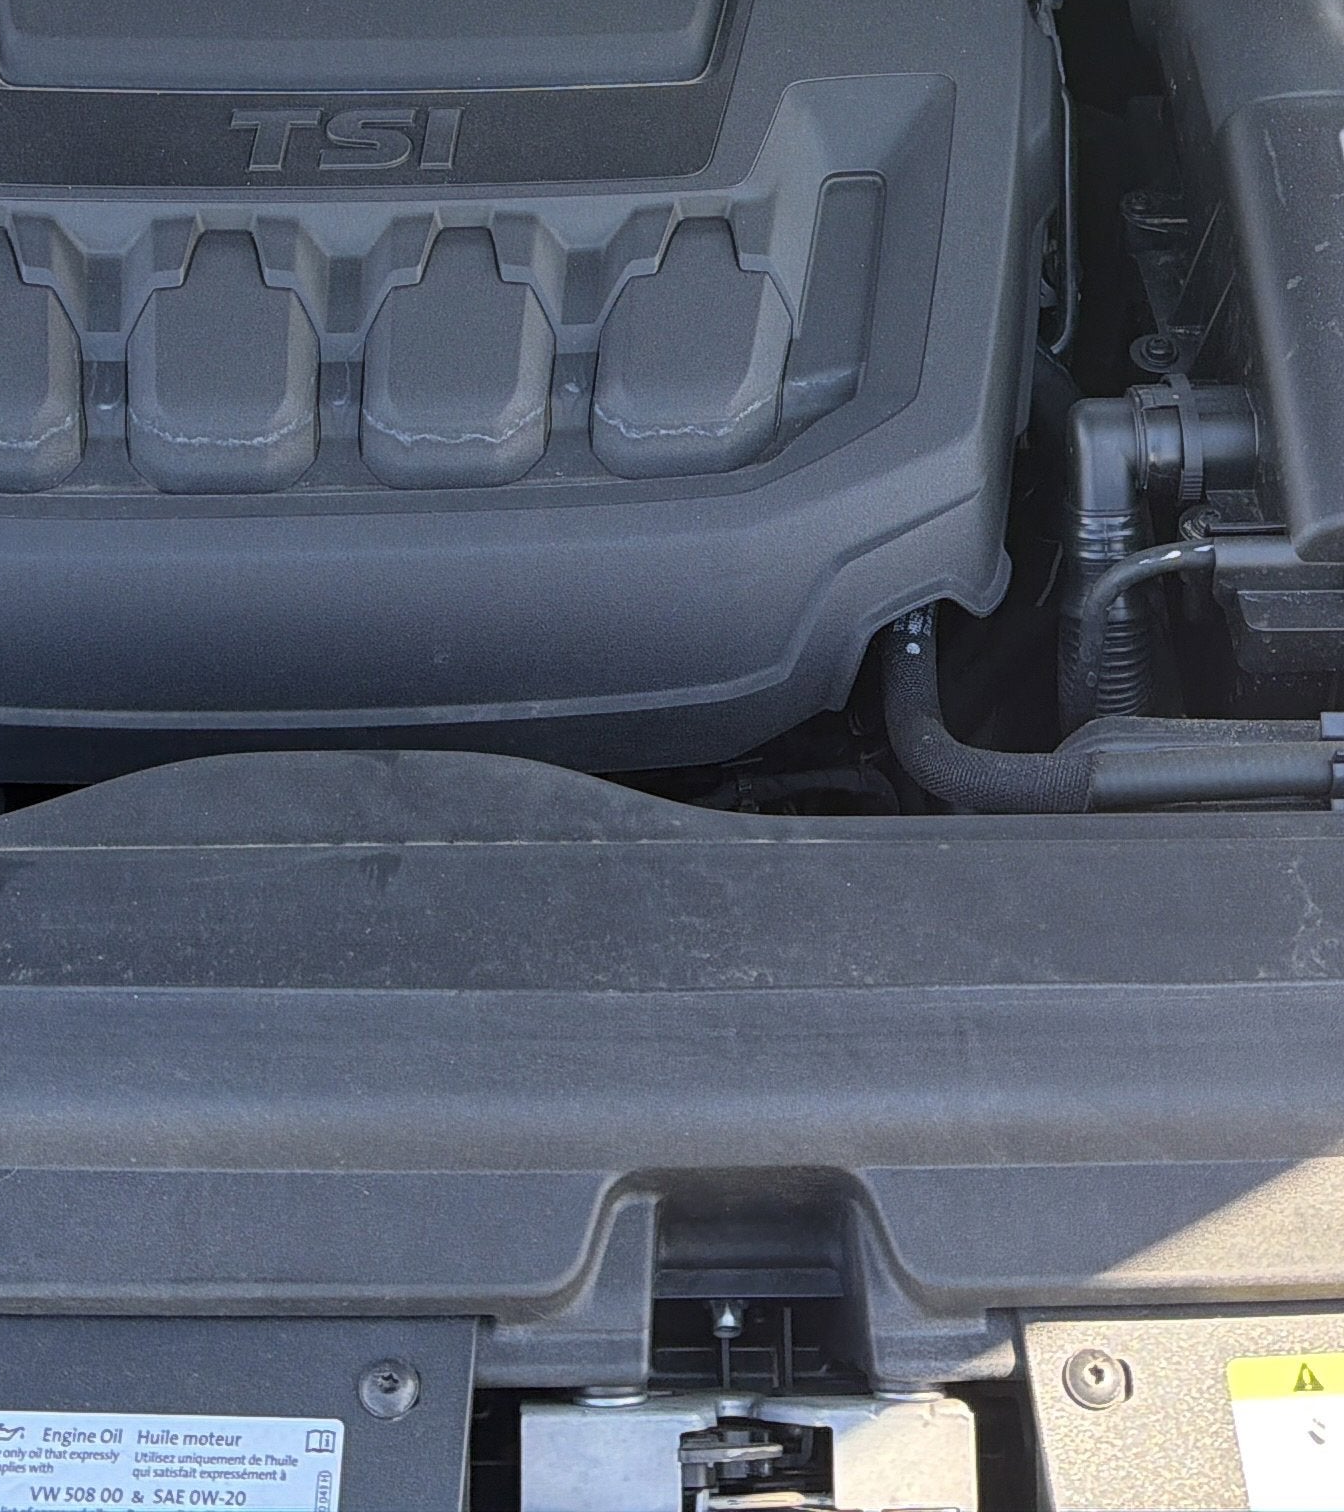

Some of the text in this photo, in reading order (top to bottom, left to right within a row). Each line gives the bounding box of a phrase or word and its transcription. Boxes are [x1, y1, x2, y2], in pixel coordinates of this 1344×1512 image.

[230, 107, 465, 172] TSI
[42, 1427, 123, 1447] Engine Oil
[137, 1429, 242, 1447] Huile moteur
[3, 1447, 27, 1462] only
[29, 1448, 42, 1459] oil
[44, 1448, 67, 1460] that
[68, 1450, 120, 1464] expressly
[134, 1451, 298, 1467] Utilisez uniquement de l'huile
[29, 1462, 54, 1474] with
[132, 1467, 287, 1482] qui satisfait expressément à
[30, 1486, 247, 1506] VW 508 00 & SAE 0W-20
